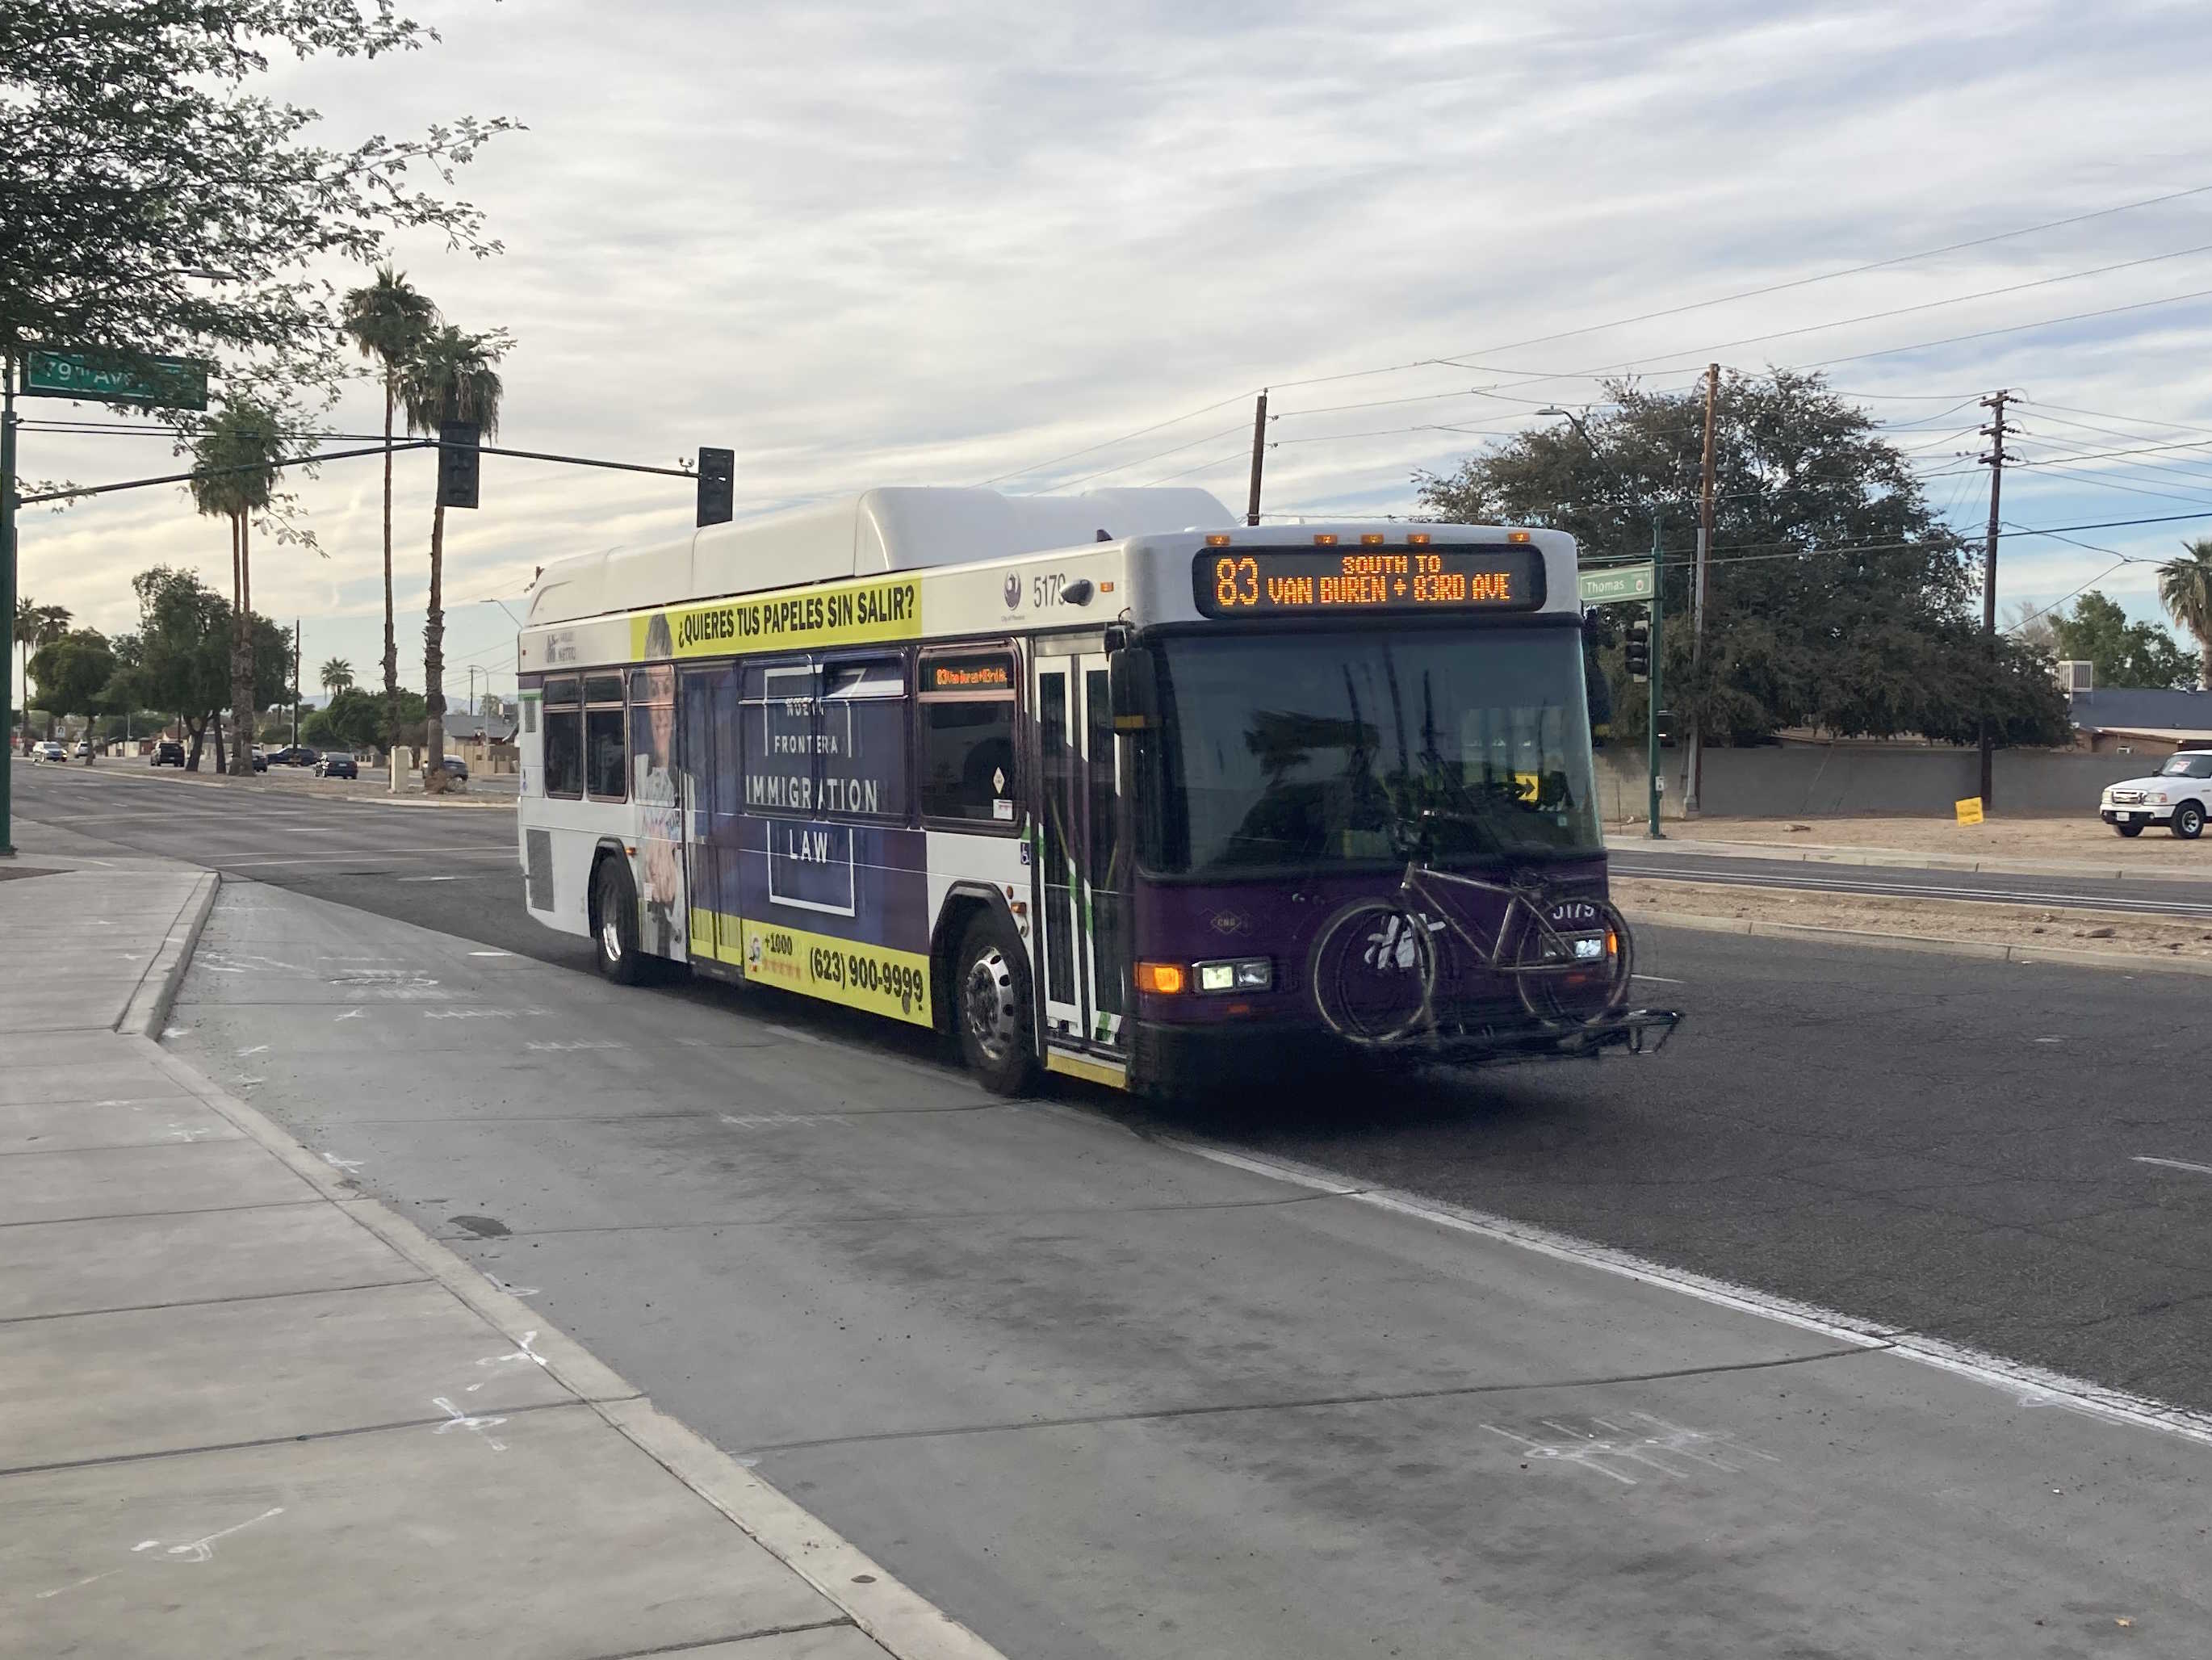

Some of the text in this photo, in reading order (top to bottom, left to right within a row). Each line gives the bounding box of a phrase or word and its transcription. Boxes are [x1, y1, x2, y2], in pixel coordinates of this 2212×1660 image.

[1216, 556, 1259, 606] 83
[1342, 555, 1442, 575] SOUTH TO
[1267, 576, 1313, 605] VAN
[1319, 576, 1387, 604] BUREN
[1414, 575, 1465, 601] 83RD
[1472, 573, 1511, 601] AVE
[1586, 581, 1624, 593] Thomas
[678, 585, 915, 648] ¿QUIERES TUS PAPELES SIN SALIR?
[774, 735, 838, 753] FRONTERA
[746, 774, 878, 812] IMMIGRATION
[790, 828, 827, 863] LAW
[765, 933, 793, 956] +1000
[811, 946, 923, 1003] (623) 900-9999
